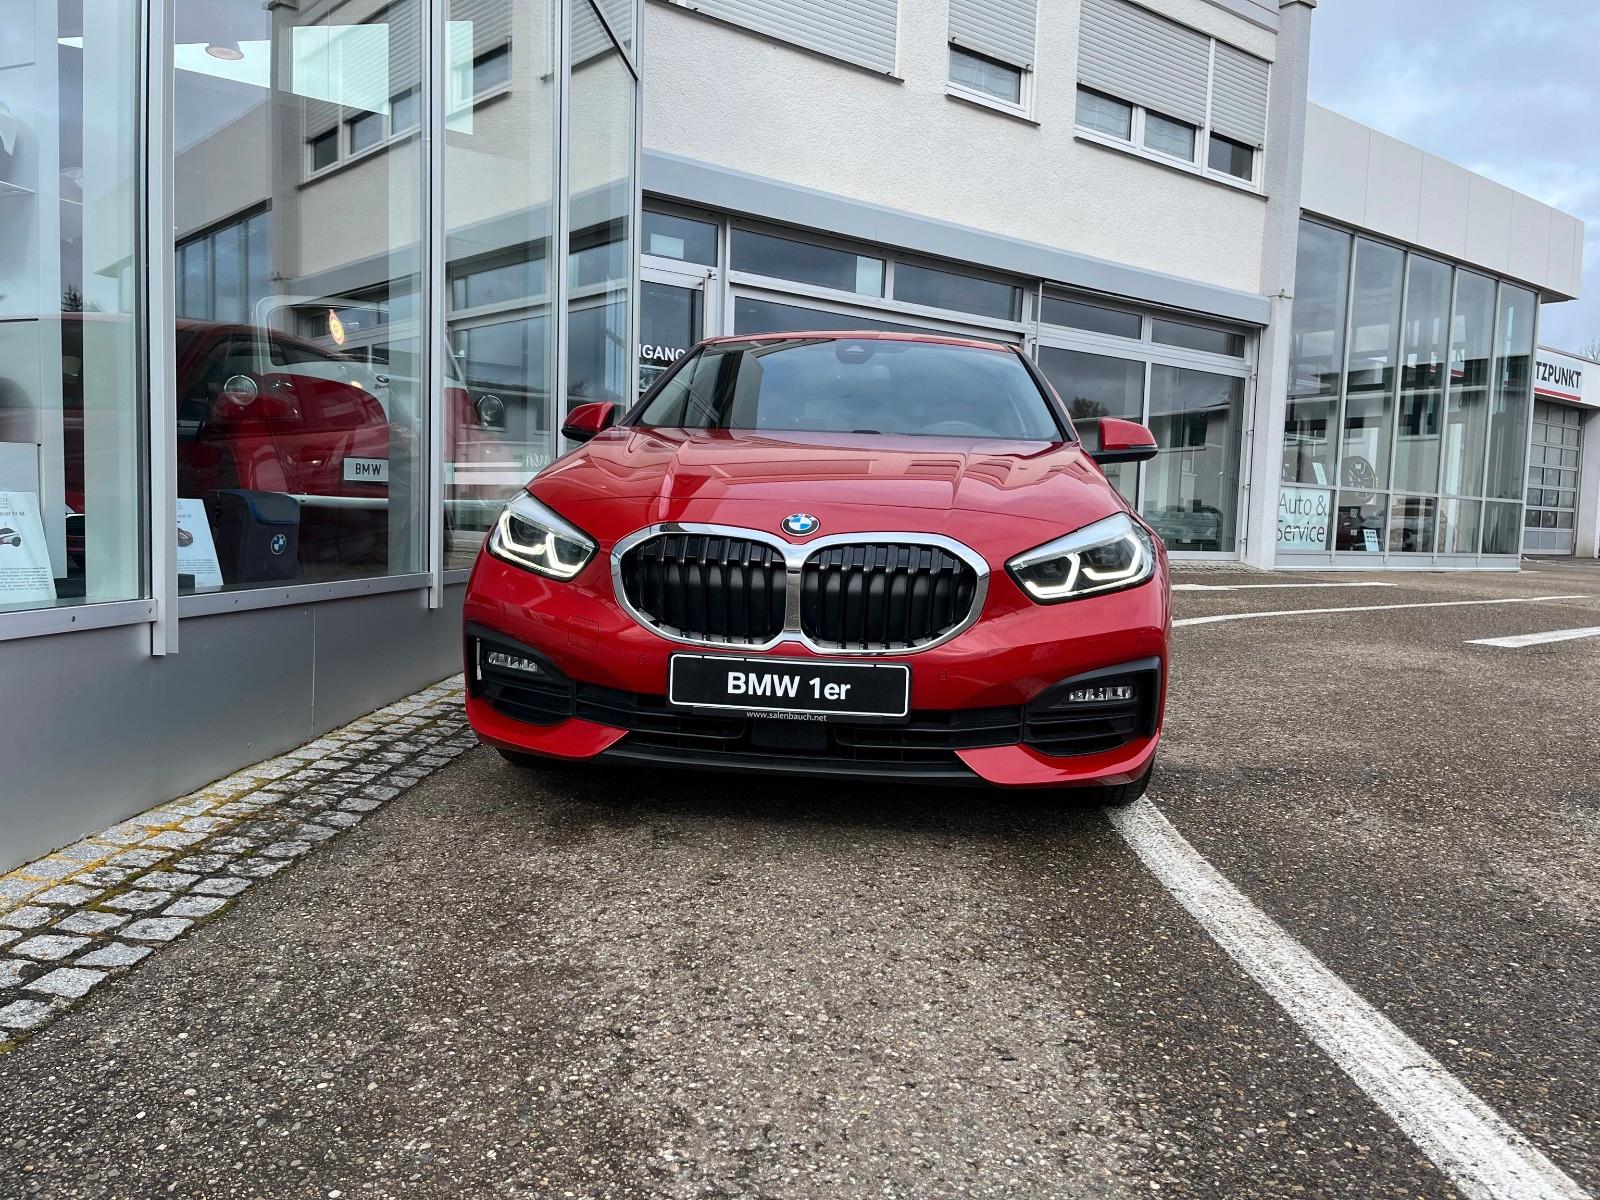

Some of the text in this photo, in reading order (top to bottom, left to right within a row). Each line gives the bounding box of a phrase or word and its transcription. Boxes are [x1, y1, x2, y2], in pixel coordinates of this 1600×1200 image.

[355, 462, 382, 476] BMW
[1279, 493, 1327, 516] Auto &
[727, 671, 851, 700] BMW 1er
[746, 711, 827, 722] www.salenbauch.net
